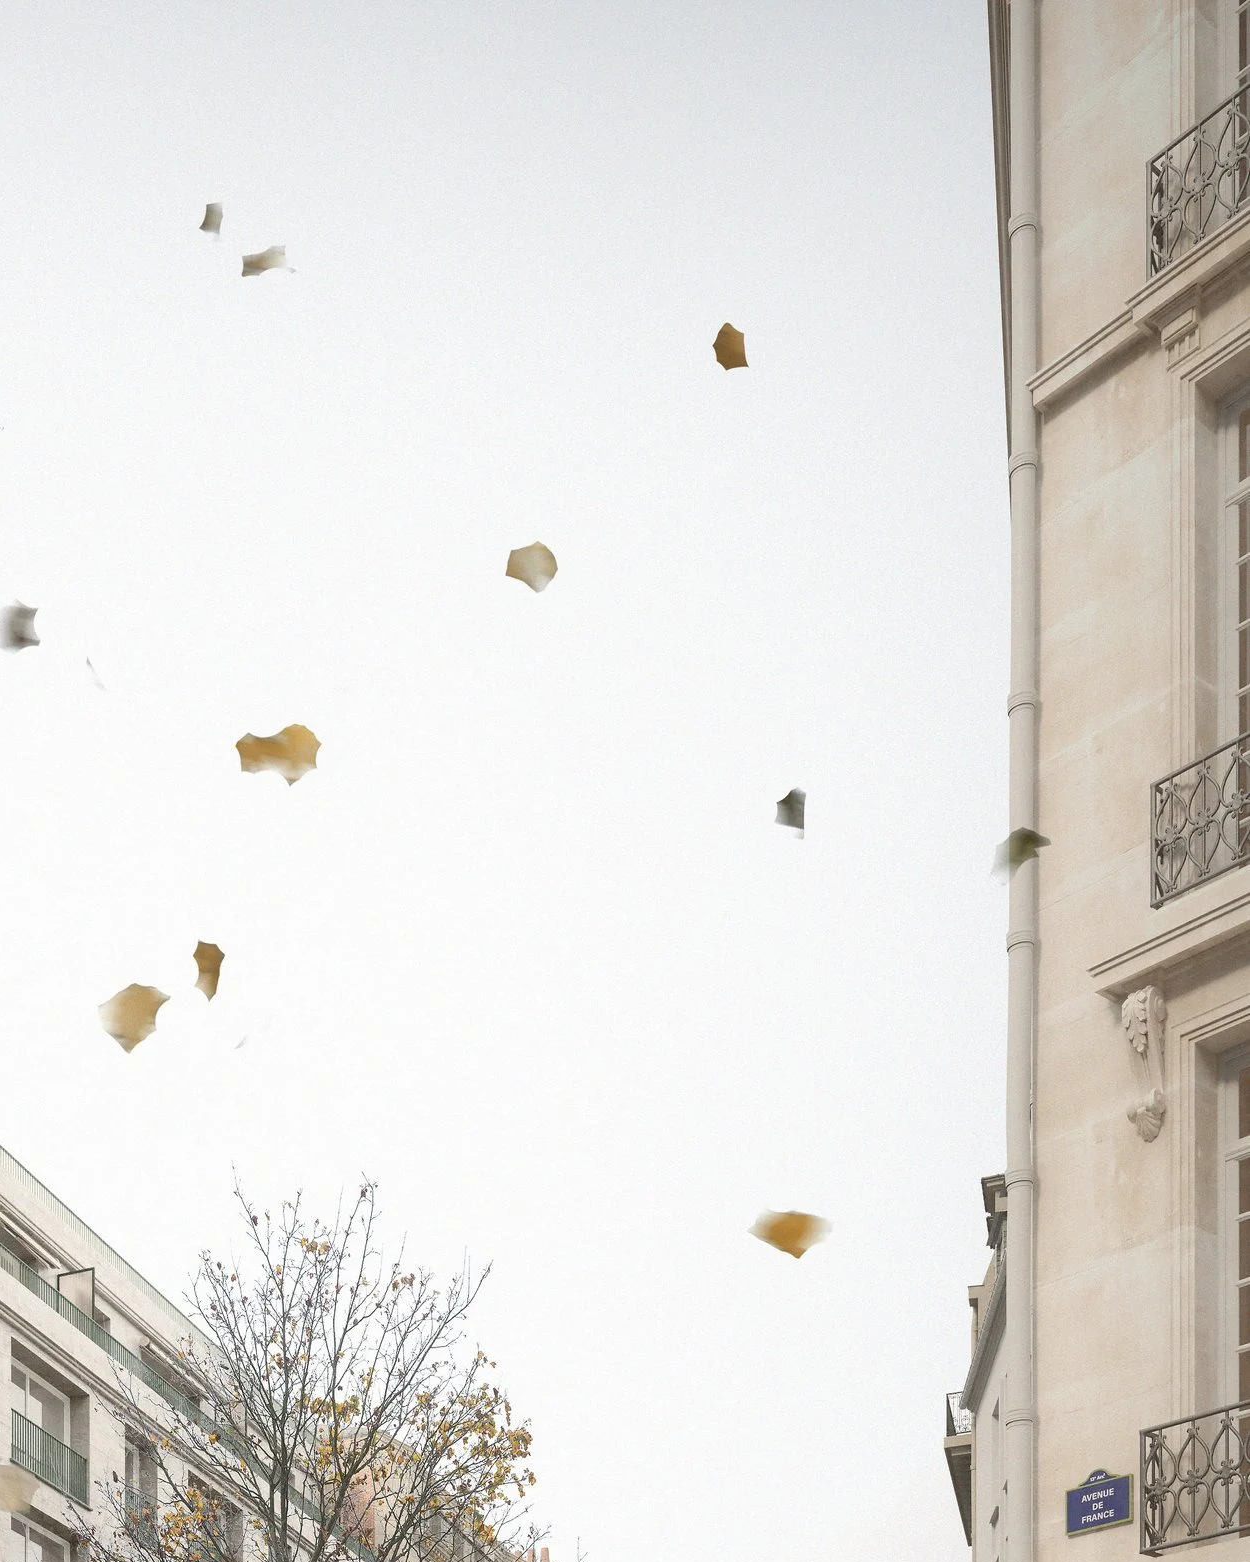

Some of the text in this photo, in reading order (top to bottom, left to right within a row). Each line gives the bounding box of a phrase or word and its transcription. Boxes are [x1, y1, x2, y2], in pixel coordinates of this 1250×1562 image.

[1081, 1488, 1114, 1503] AVENUE
[1092, 1502, 1103, 1510] DE
[1081, 1509, 1114, 1524] FRANCE
